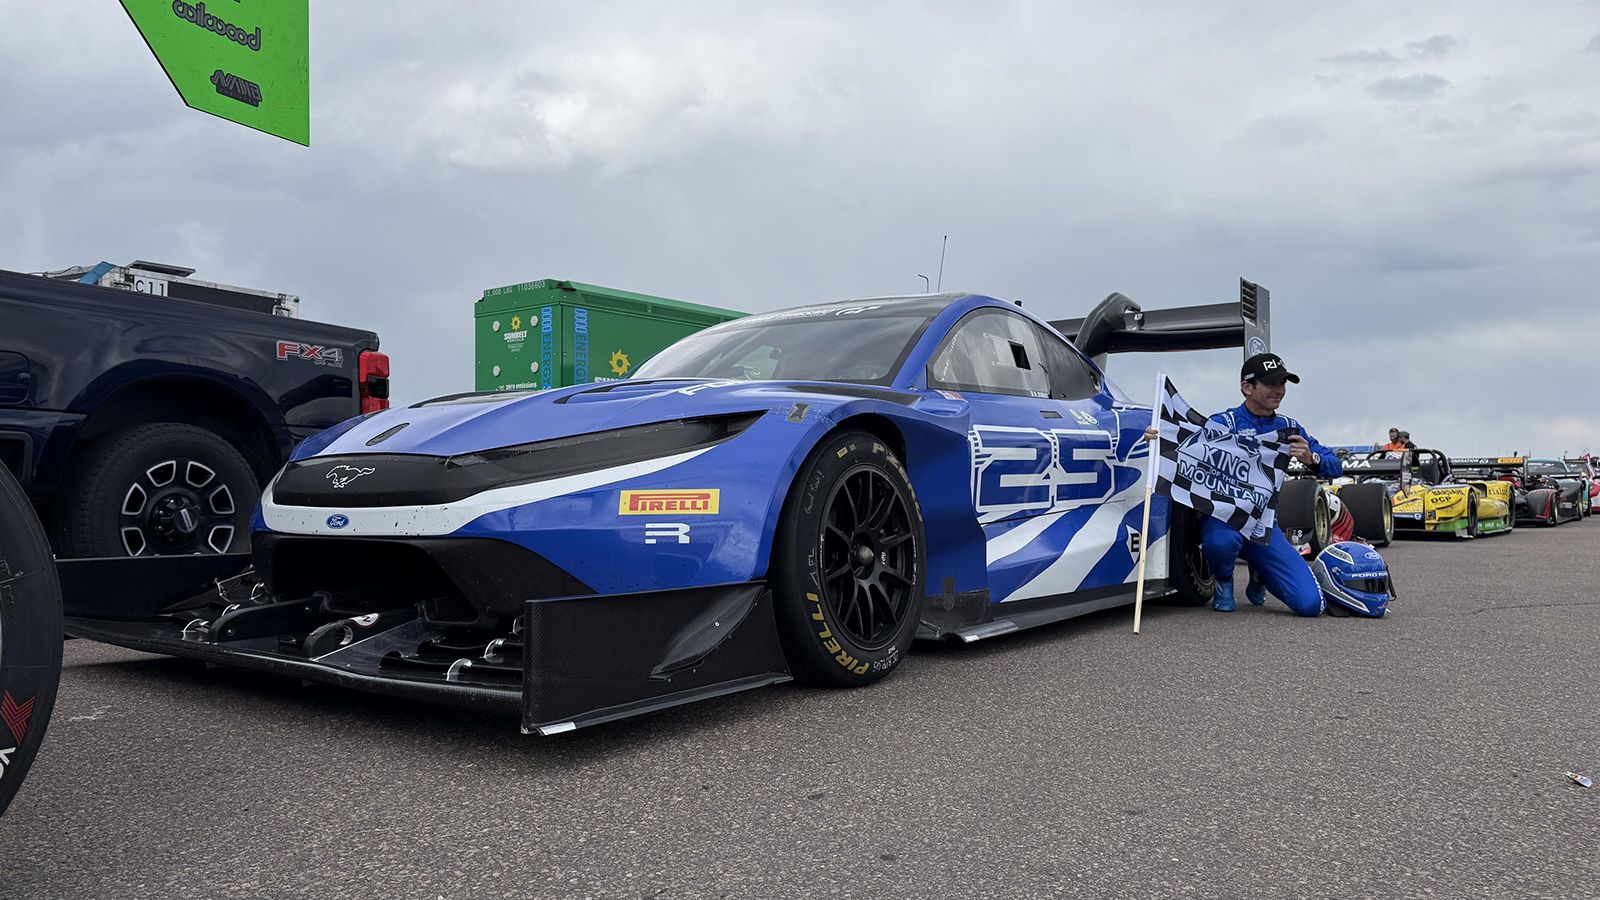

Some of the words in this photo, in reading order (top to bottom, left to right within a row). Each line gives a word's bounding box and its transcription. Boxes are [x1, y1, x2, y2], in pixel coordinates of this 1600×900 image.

[172, 0, 261, 51] wilwood
[135, 279, 164, 297] C11
[504, 330, 528, 340] SUNBELT
[276, 340, 343, 363] FX4
[541, 333, 552, 384] ENERGY
[968, 424, 1118, 513] 25
[1203, 444, 1250, 483] KING
[1211, 468, 1220, 477] OF
[1222, 474, 1237, 485] THE
[1179, 461, 1268, 509] MOUNTAIN
[629, 493, 711, 511] PIRELLI
[328, 515, 348, 528] Ford
[806, 592, 870, 675] PIRELLI
